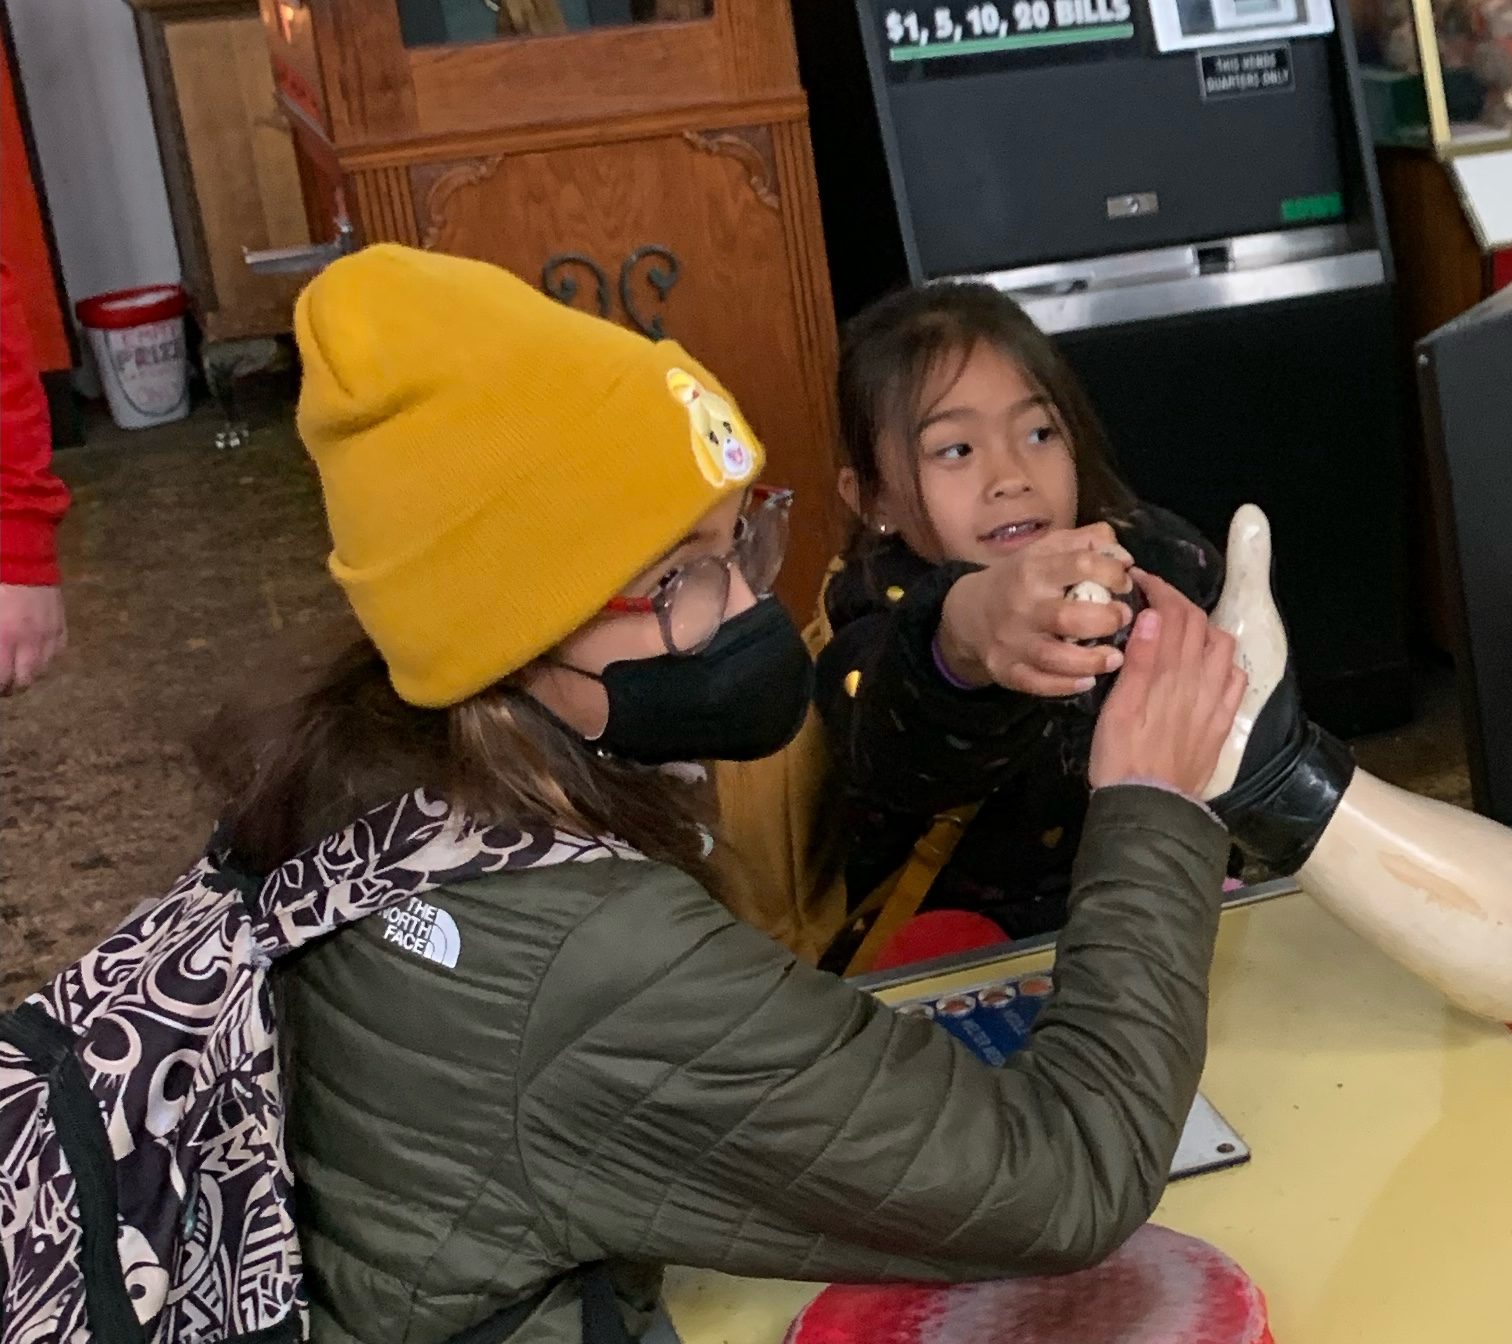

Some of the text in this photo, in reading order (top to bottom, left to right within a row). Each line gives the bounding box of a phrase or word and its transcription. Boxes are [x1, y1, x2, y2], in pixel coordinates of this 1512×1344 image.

[885, 8, 929, 47] $1,
[934, 7, 963, 43] 5,
[965, 1, 1009, 39] 10,
[1206, 68, 1289, 93] QUARTERS ONLY
[407, 897, 438, 923] THE
[383, 924, 427, 955] FACE
